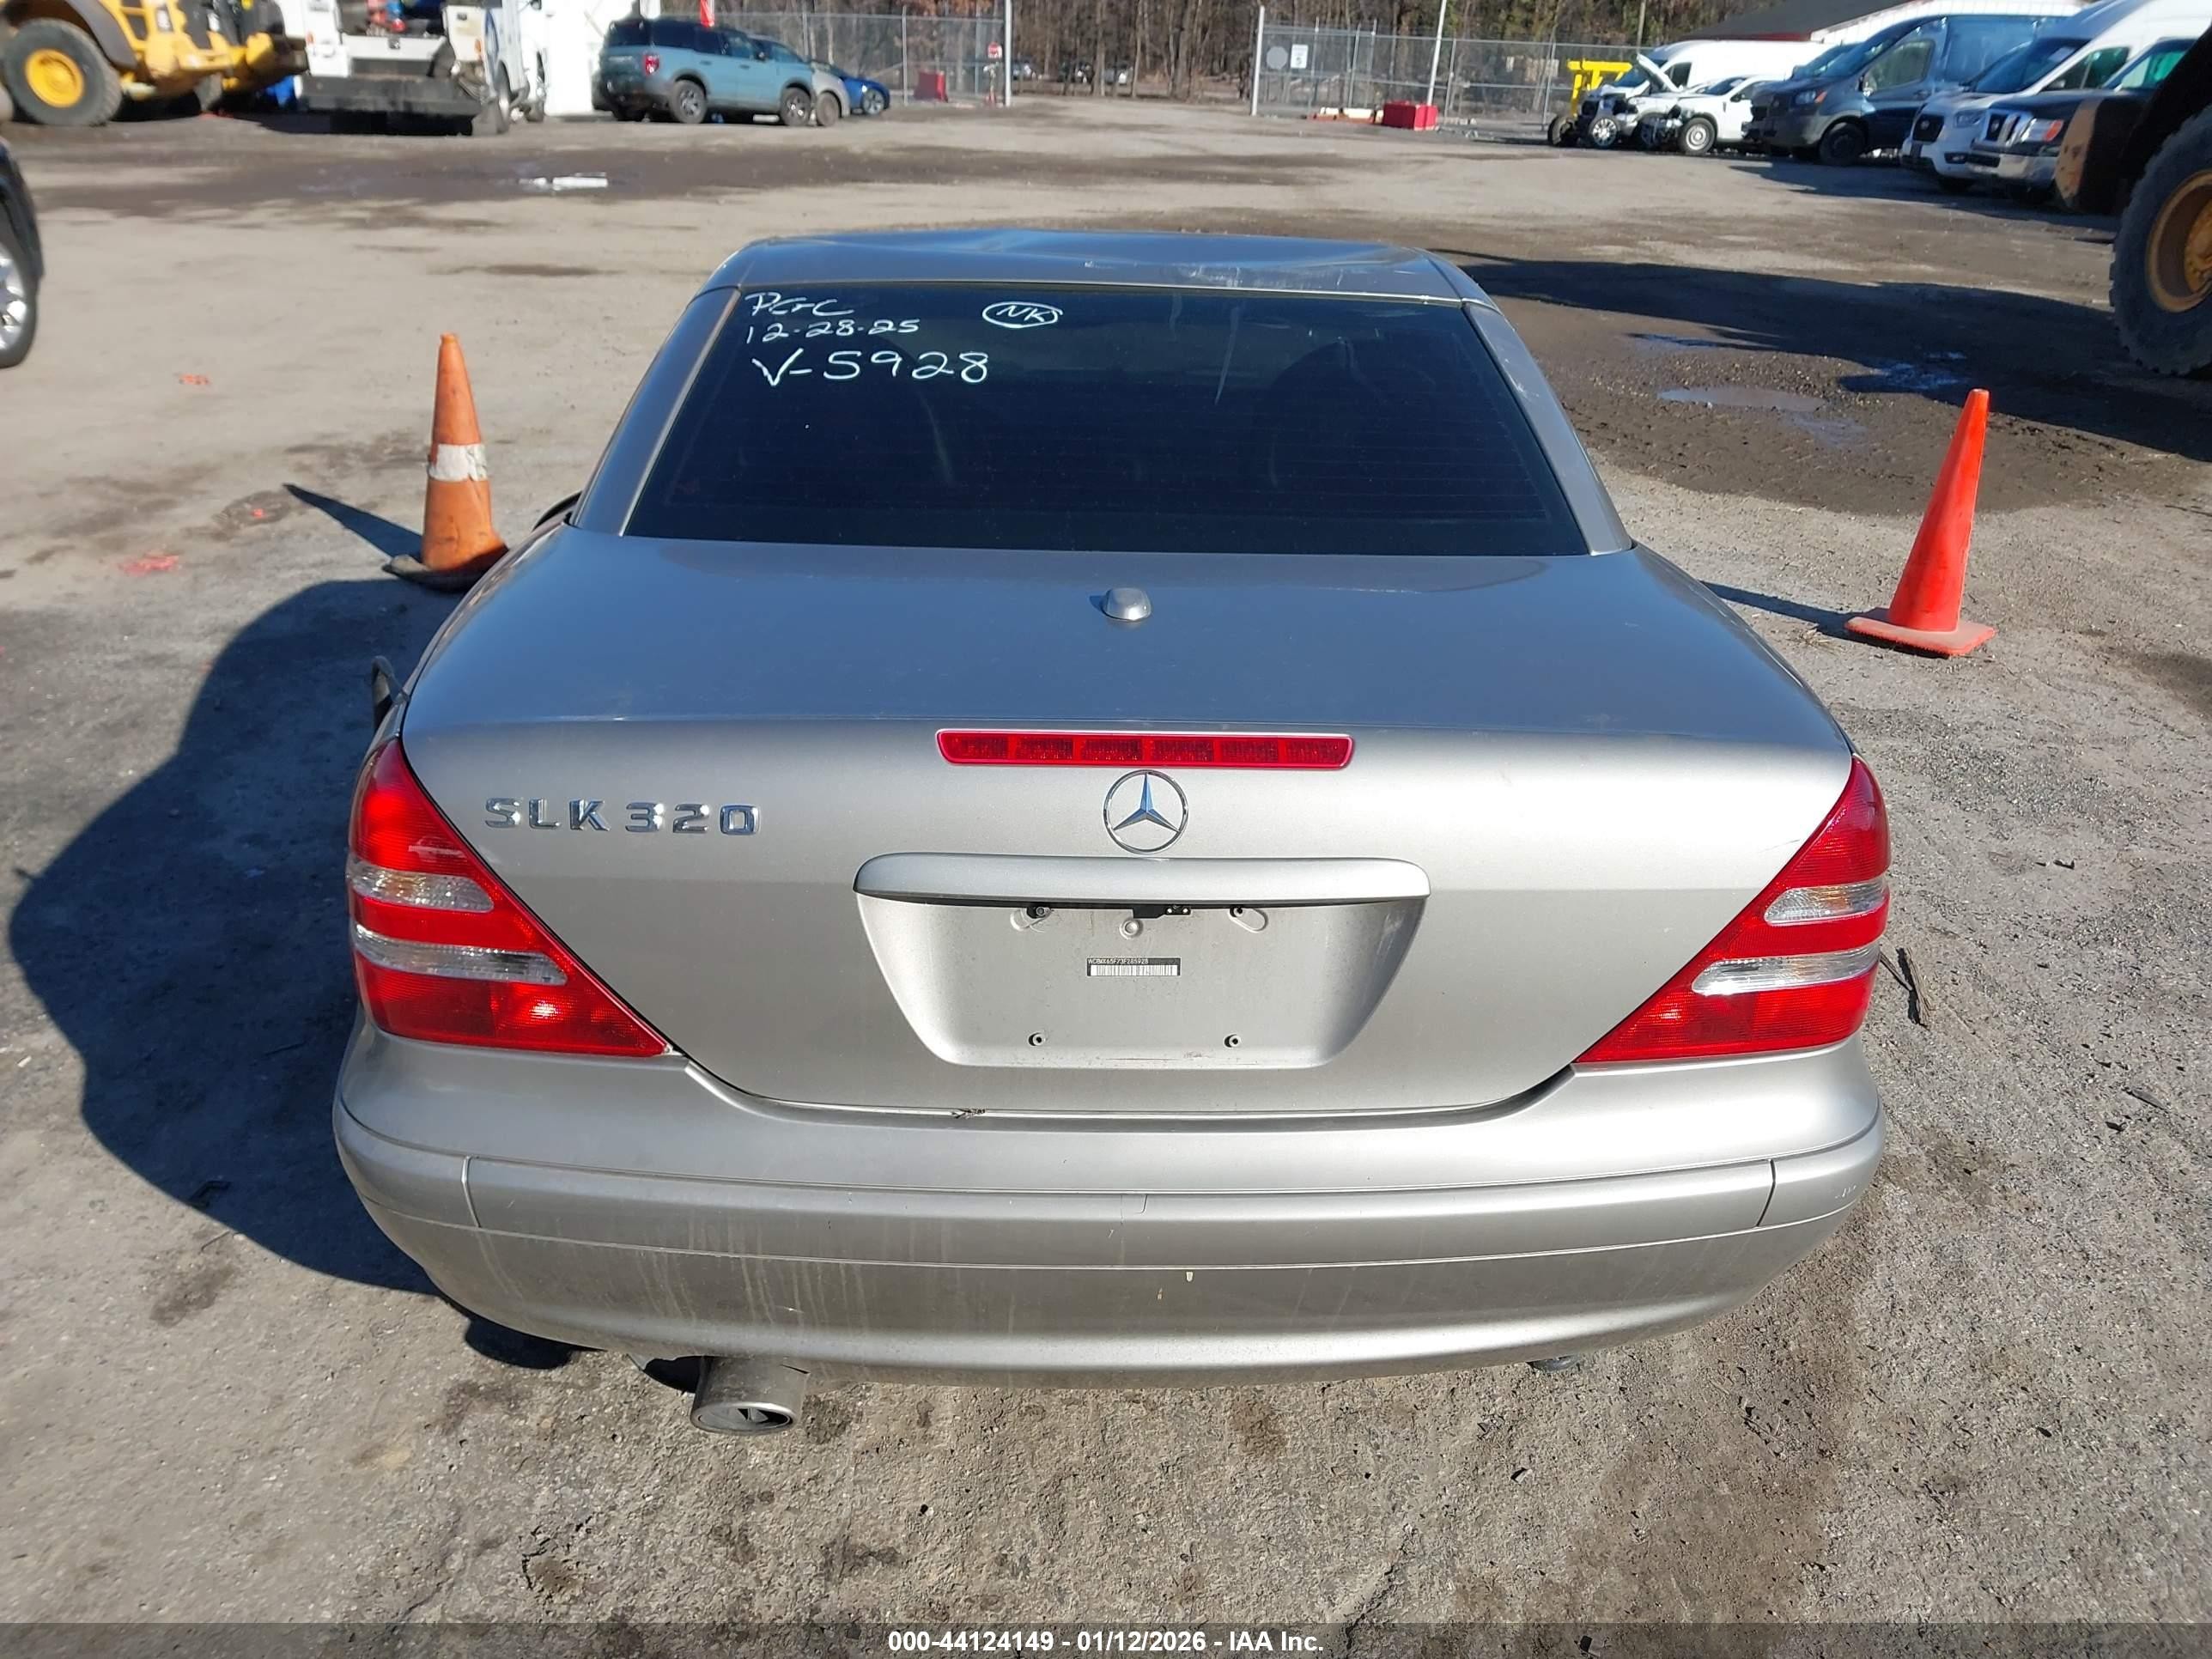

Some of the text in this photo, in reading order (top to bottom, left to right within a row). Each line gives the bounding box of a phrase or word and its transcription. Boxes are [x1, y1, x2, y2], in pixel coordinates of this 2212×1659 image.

[996, 305, 1051, 323] NK
[751, 348, 988, 386] V-5928
[485, 797, 760, 836] SLK 320
